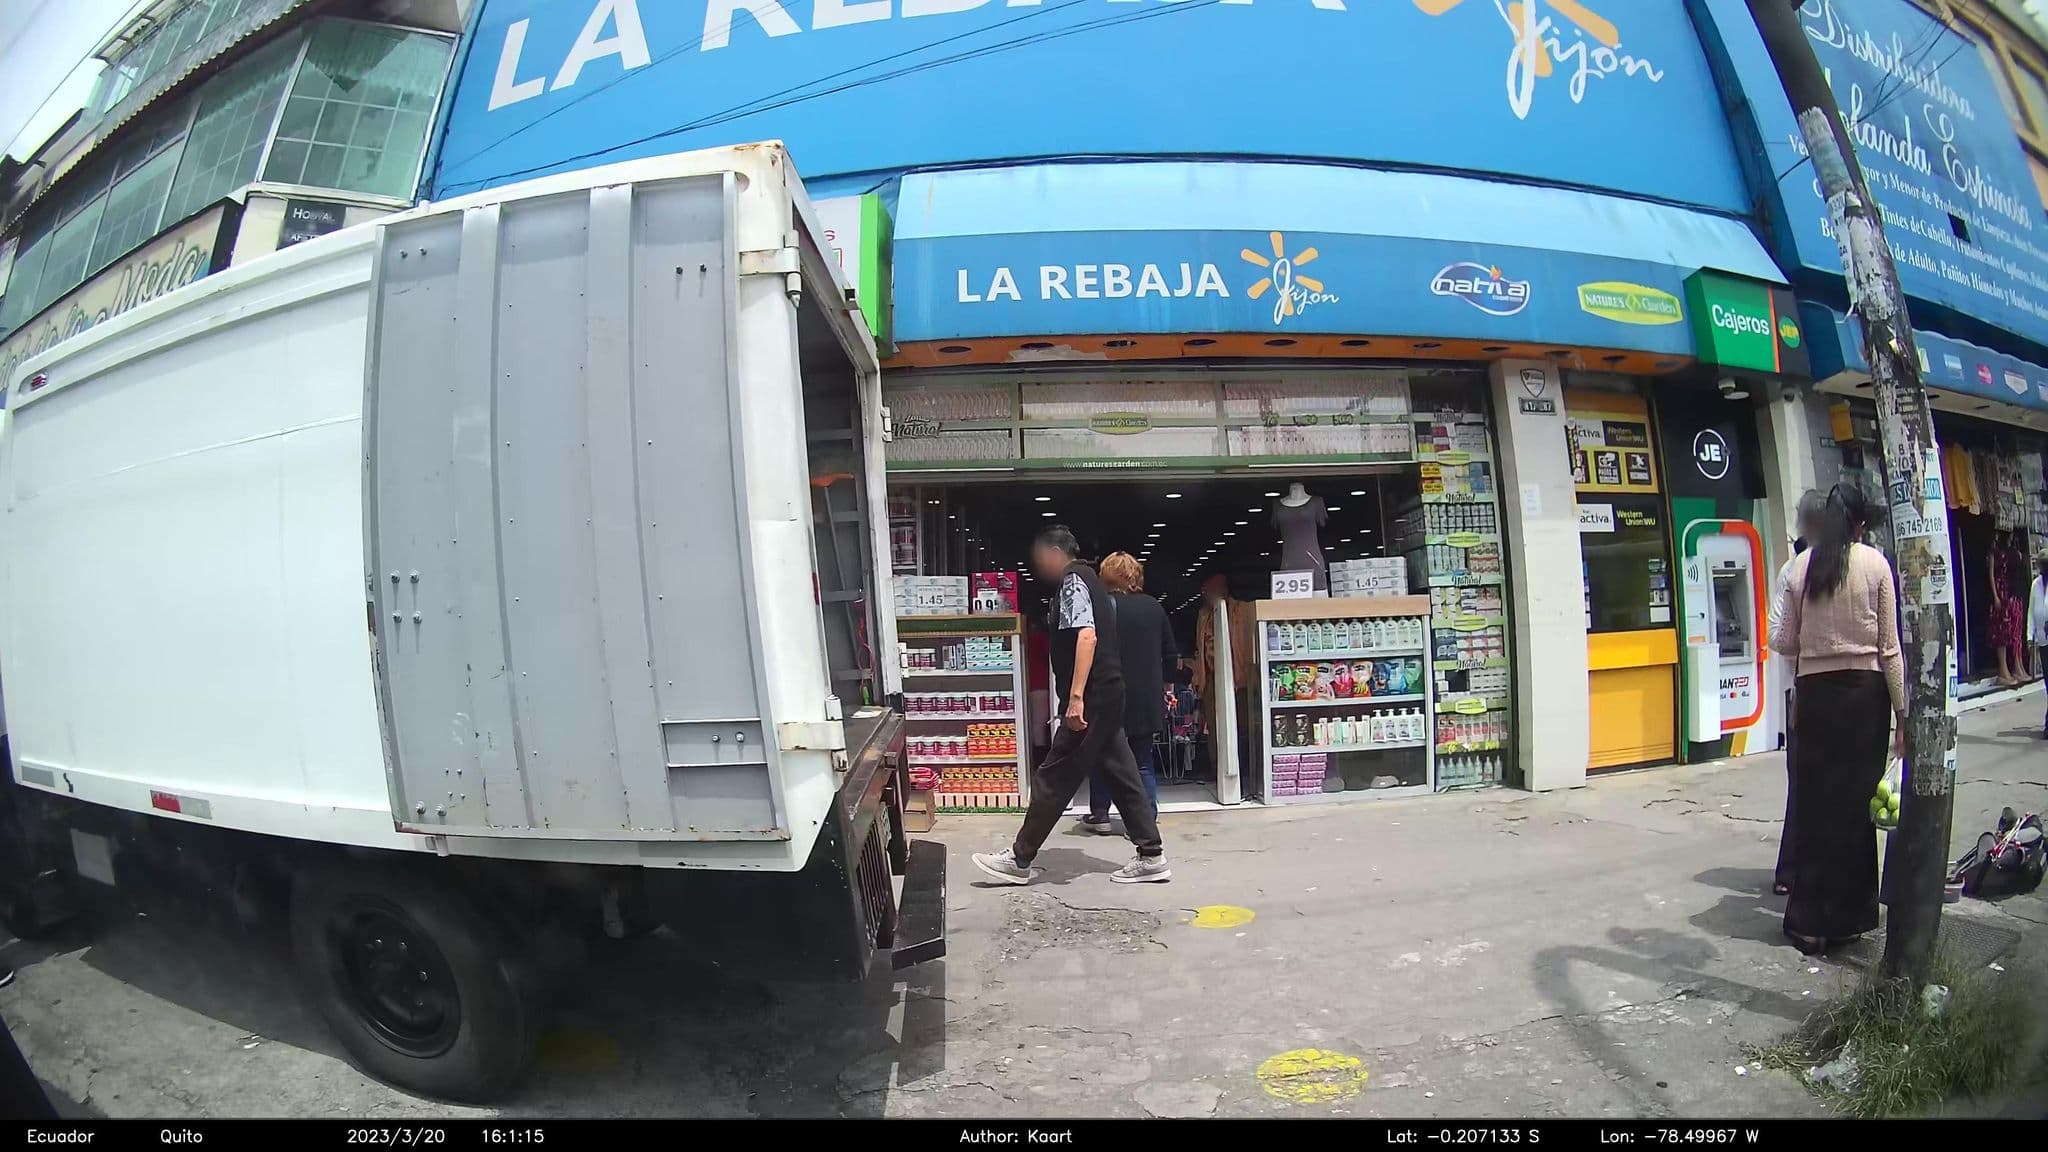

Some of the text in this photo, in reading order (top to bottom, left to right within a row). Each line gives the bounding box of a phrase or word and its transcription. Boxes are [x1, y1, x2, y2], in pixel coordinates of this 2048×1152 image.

[487, 0, 652, 112] LA
[1889, 172, 1919, 200] Menor
[1921, 186, 1932, 205] de
[1879, 203, 1909, 231] Tintes
[1910, 216, 1921, 236] de
[1895, 241, 1906, 263] de
[957, 262, 1231, 303] LA REBAJA
[1712, 304, 1770, 336] Cajeros
[1580, 509, 1643, 524] activa Western
[1906, 519, 1922, 535] 745
[1275, 578, 1310, 594] 2.95
[1355, 577, 1379, 589] 1.45
[918, 595, 943, 605] 1.45
